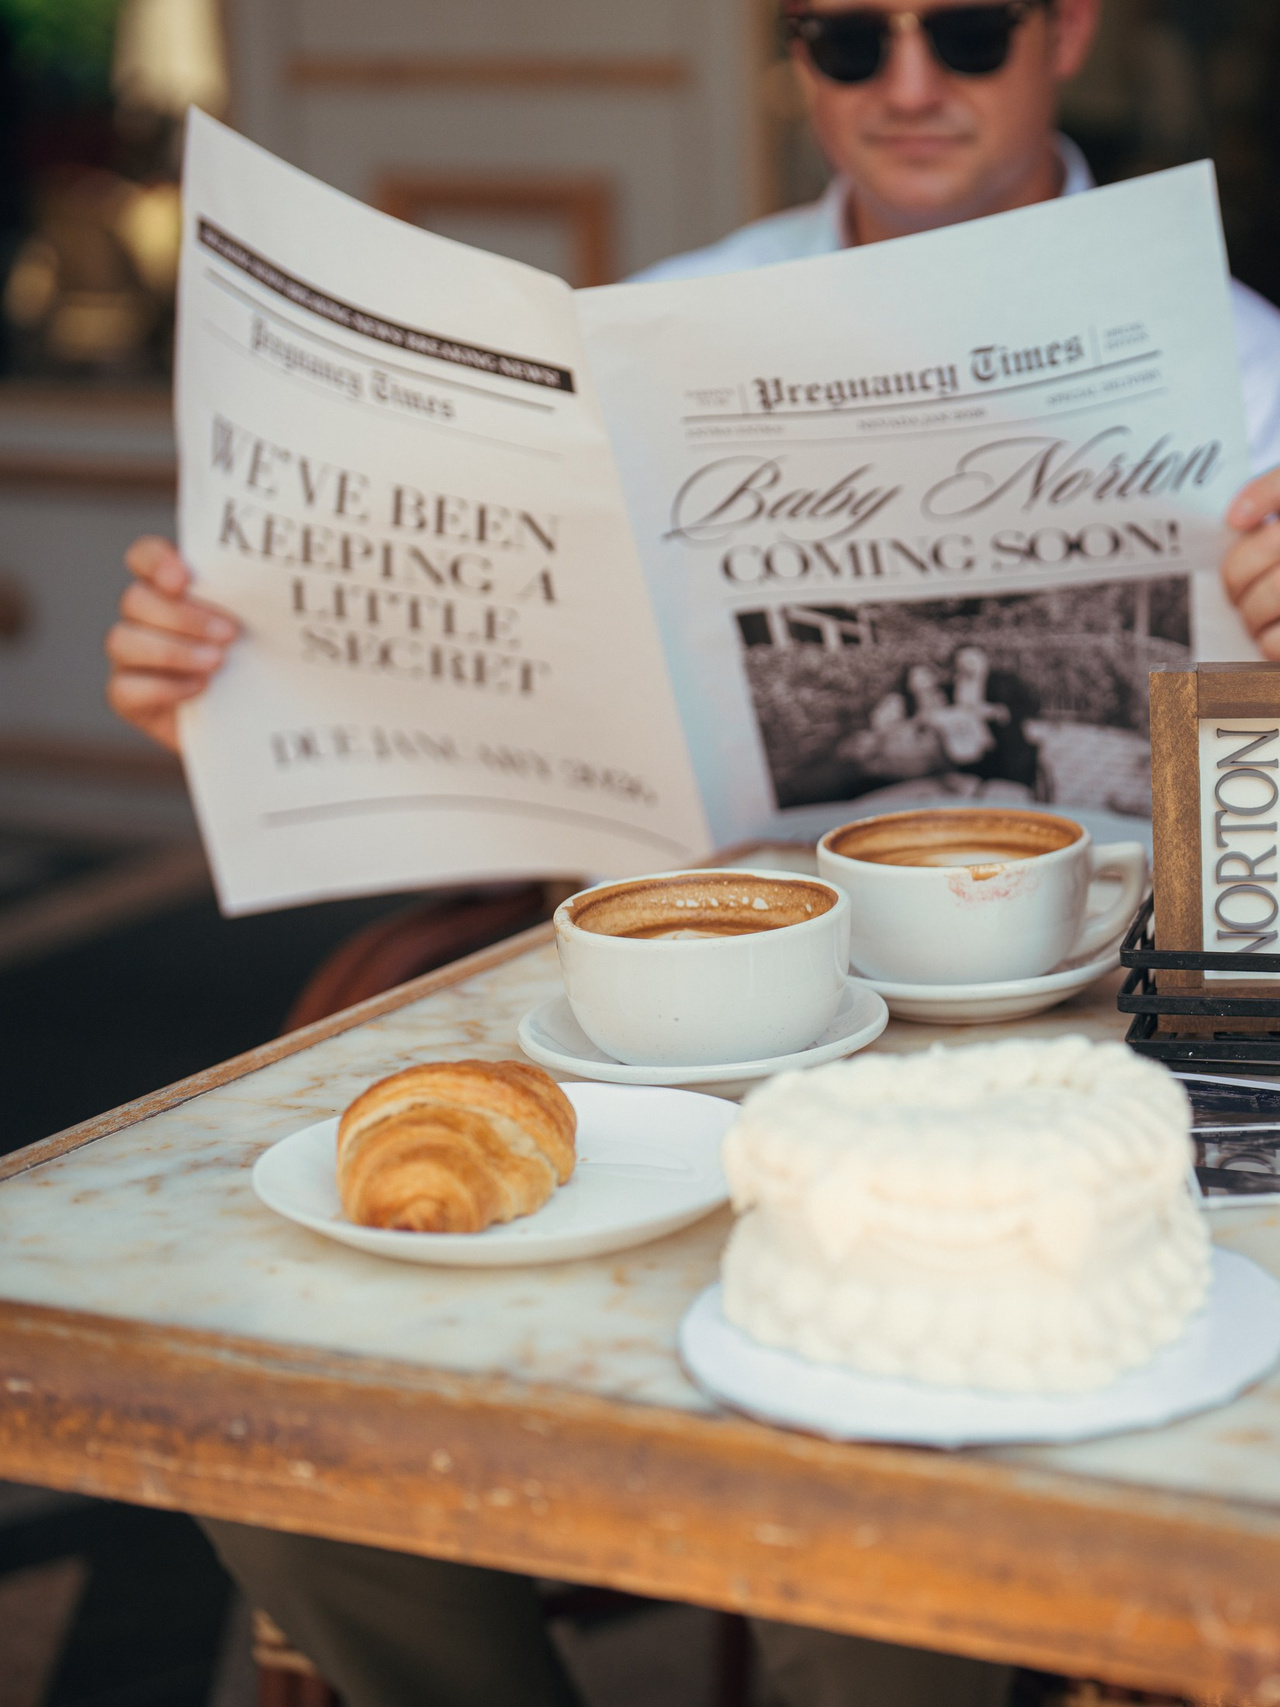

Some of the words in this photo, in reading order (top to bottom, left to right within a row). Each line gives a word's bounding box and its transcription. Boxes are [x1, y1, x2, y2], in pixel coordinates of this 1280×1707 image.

[752, 359, 960, 416] Pregnancy
[968, 334, 1085, 384] Times
[211, 413, 369, 520] WE'VE
[392, 484, 559, 554] BEEN
[662, 452, 904, 544] Baby
[920, 425, 1223, 524] Norton
[219, 499, 493, 595] KEEPING
[518, 568, 557, 604] A
[721, 535, 977, 589] COMING
[991, 519, 1182, 568] SOON!
[291, 577, 522, 651] LITTLE
[302, 627, 552, 697] SECRET
